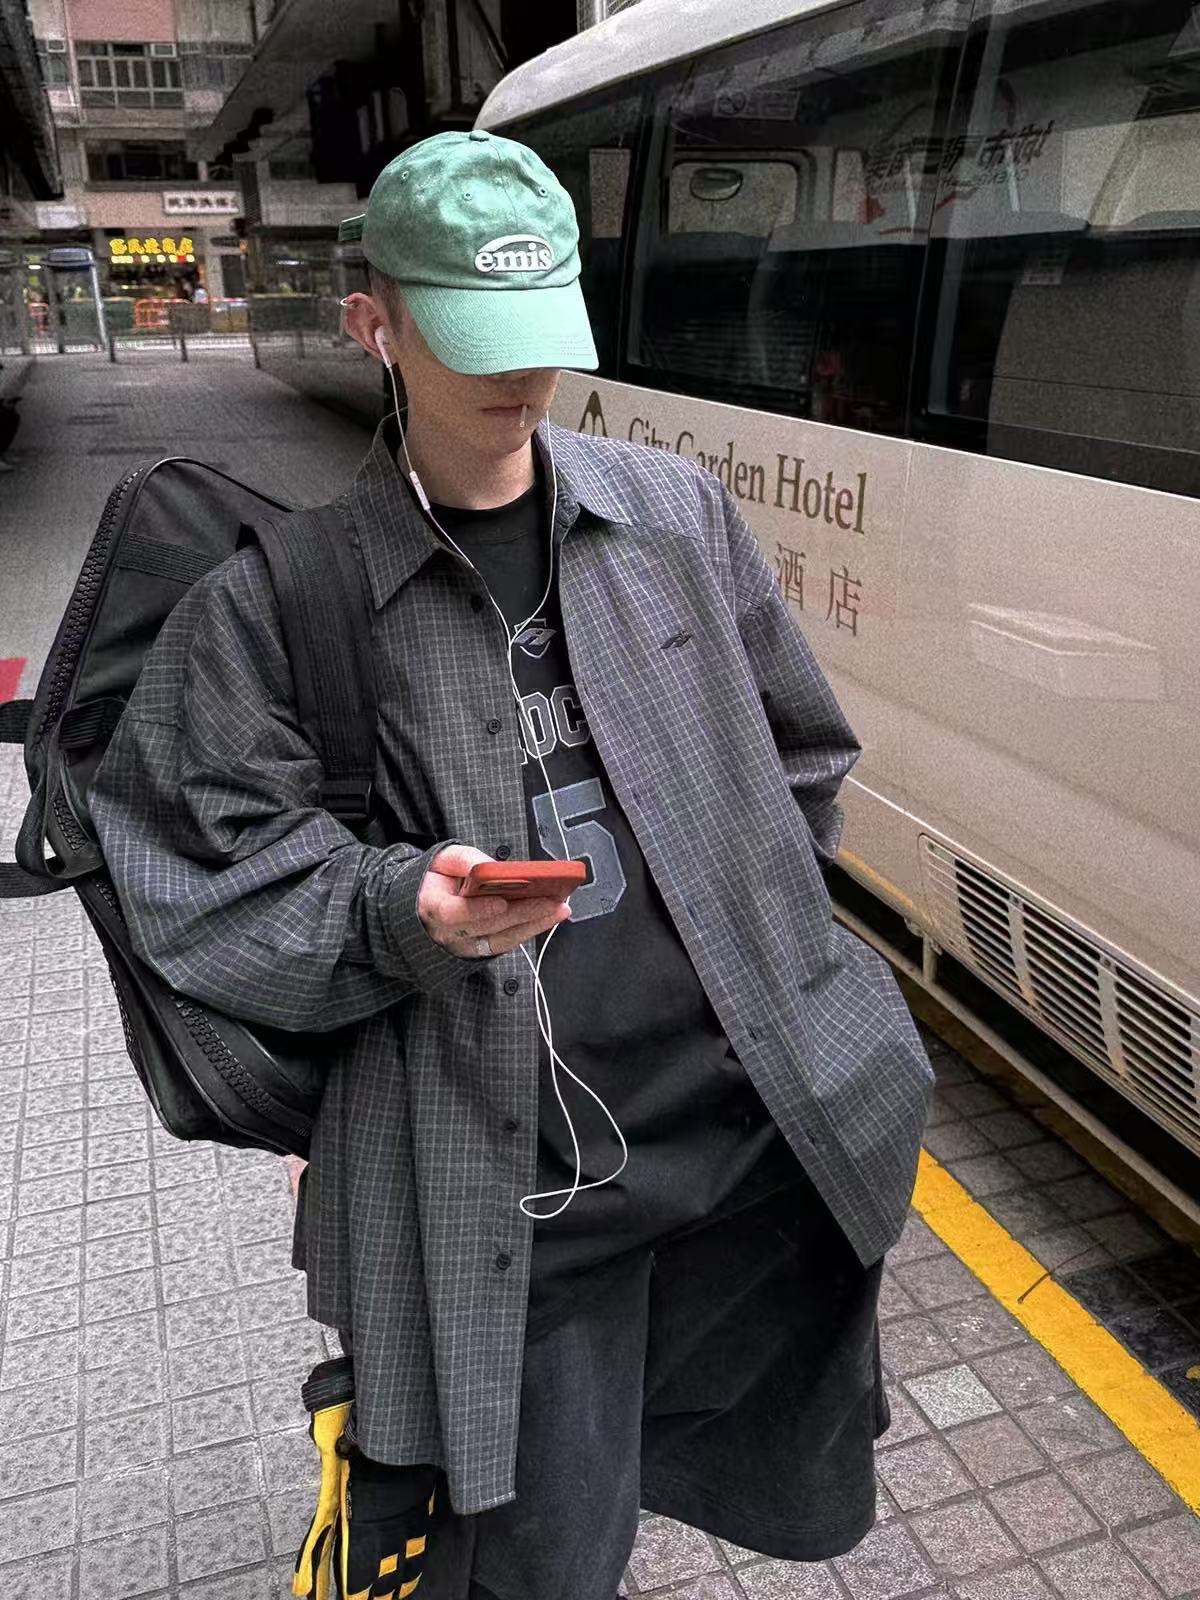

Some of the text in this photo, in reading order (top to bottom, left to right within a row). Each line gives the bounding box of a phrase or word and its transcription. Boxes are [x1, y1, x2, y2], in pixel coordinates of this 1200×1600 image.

[475, 241, 553, 273] emis
[628, 417, 671, 452] Ci
[773, 452, 867, 535] Hotel
[775, 542, 863, 637] 酒店
[517, 684, 592, 766] OC
[531, 777, 627, 922] 5
